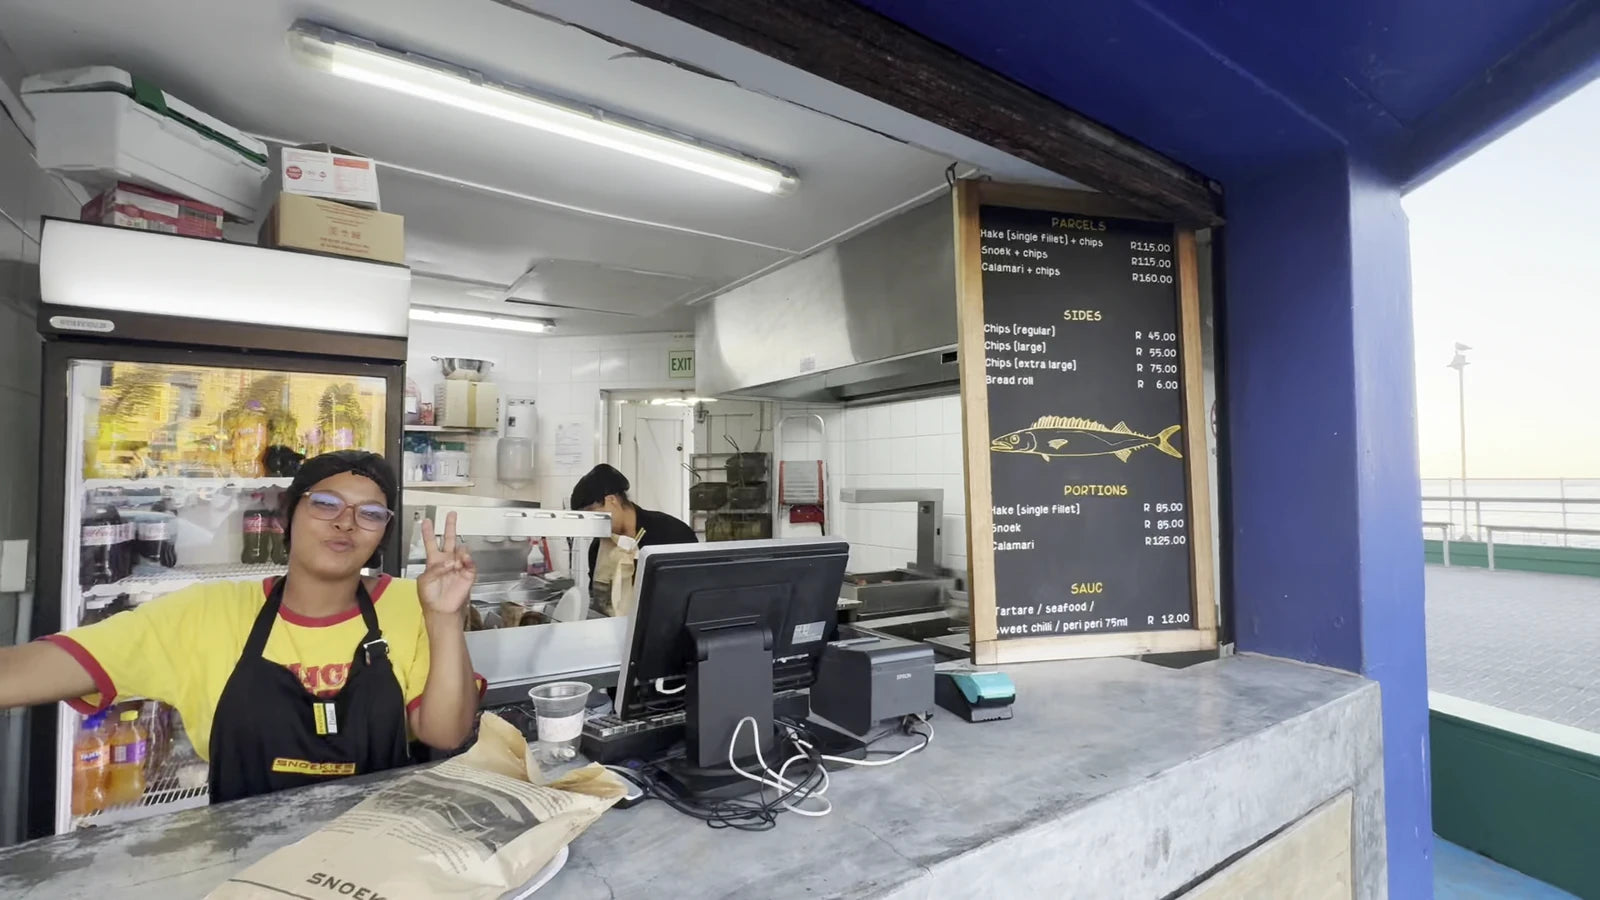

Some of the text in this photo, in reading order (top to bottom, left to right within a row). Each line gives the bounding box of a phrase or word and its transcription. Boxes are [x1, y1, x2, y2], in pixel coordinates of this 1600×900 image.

[1051, 217, 1106, 231] PARCELS
[980, 229, 1004, 239] Hake
[1079, 236, 1104, 248] chips
[1130, 241, 1171, 252] R115.00
[981, 245, 1011, 256] Snoek
[1023, 249, 1048, 260] chips
[1131, 257, 1171, 268] R115.00
[981, 262, 1024, 274] Calamari
[1035, 266, 1060, 277] chips
[1132, 272, 1172, 284] R160.00
[1063, 309, 1102, 321] SIDES
[984, 323, 1011, 335] Chips
[1135, 330, 1142, 340] R
[1148, 331, 1176, 342] 45.00
[984, 340, 1011, 352] Chips
[1136, 347, 1143, 356] R
[1149, 348, 1177, 358] 55.00
[671, 357, 692, 371] EXIT
[985, 357, 1012, 370] Chips
[1136, 363, 1143, 372] R
[1150, 363, 1177, 374] 75.00
[985, 375, 1178, 390] Bread roll R 6.00
[1064, 484, 1128, 496] PORTIONS
[1143, 503, 1150, 512] R
[1155, 502, 1183, 513] 85.00
[992, 519, 1184, 533] Snoek R 85.00
[993, 539, 1035, 551] Calamari
[1070, 582, 1103, 595] SAUC
[1036, 603, 1042, 615] /
[1045, 601, 1087, 614] seafood
[1089, 601, 1095, 612] /
[1030, 620, 1053, 633] chilli
[1054, 620, 1060, 632] /
[1063, 617, 1082, 632] peri
[1084, 616, 1103, 631] peri
[1105, 616, 1128, 629] 75ml
[1147, 615, 1154, 625] R
[1161, 613, 1190, 625] 12.00
